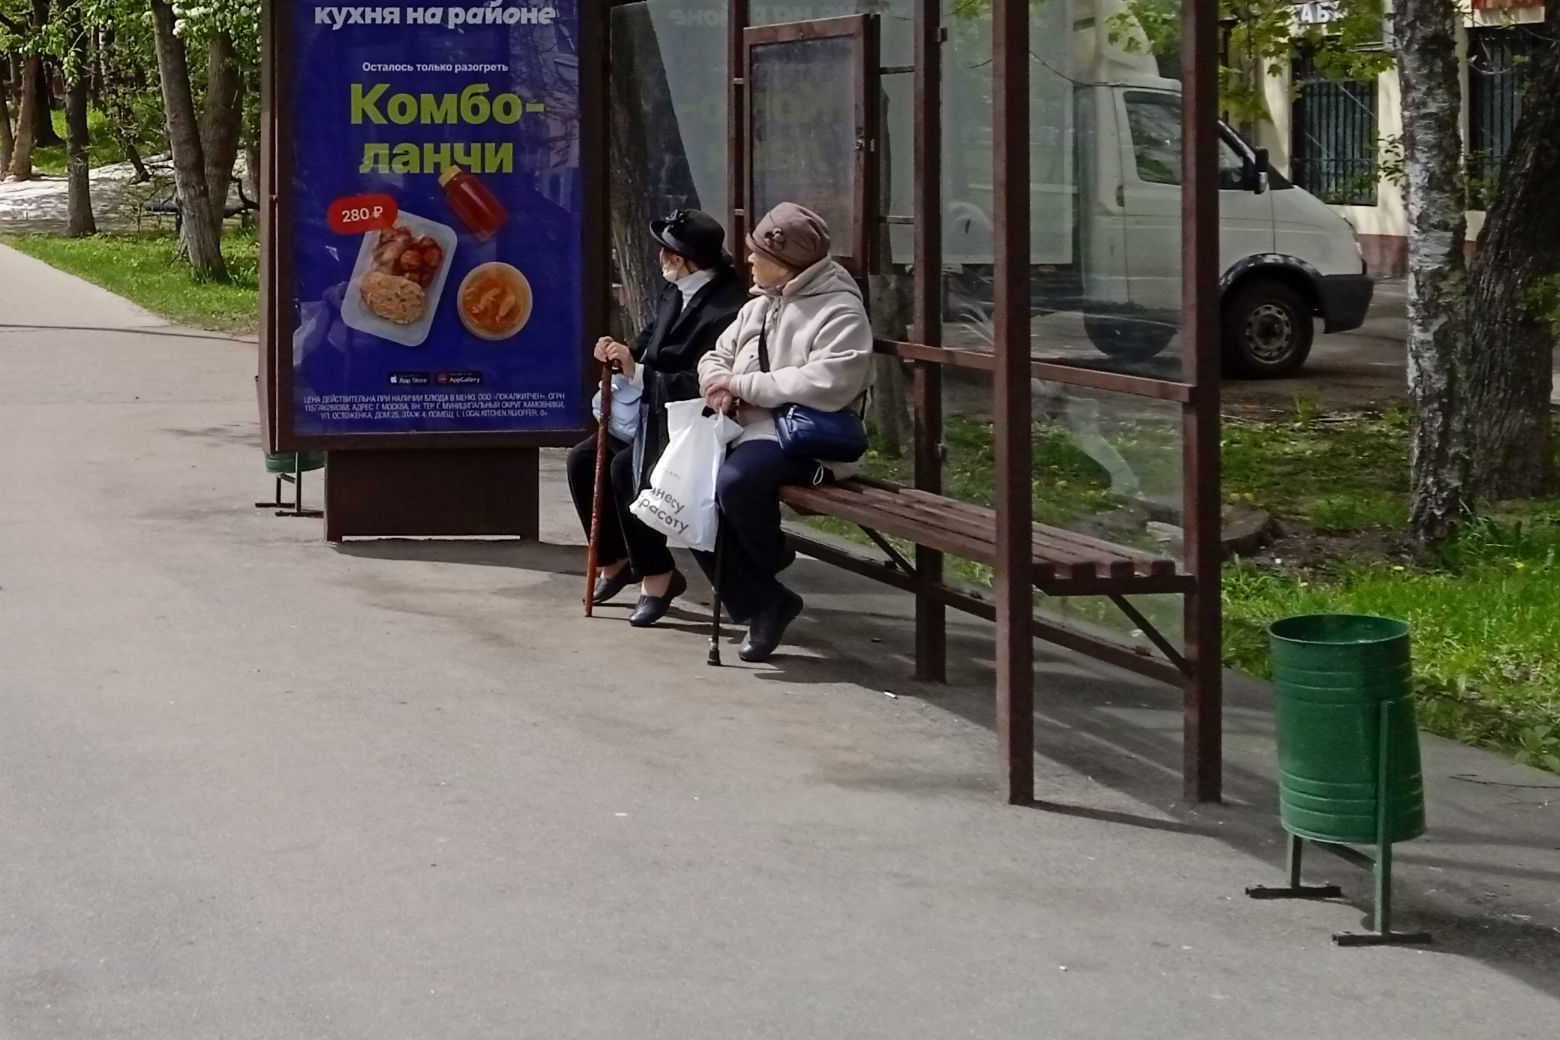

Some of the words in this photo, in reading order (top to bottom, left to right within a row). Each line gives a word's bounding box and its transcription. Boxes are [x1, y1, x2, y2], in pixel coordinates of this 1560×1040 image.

[314, 6, 401, 30] кухня
[407, 6, 443, 24] на
[447, 0, 556, 30] районе
[362, 62, 414, 72] Осталось
[416, 63, 453, 72] только
[454, 63, 509, 73] разогреть
[350, 83, 545, 125] Комбо-
[359, 142, 513, 174] ланчи
[342, 208, 370, 223] 280
